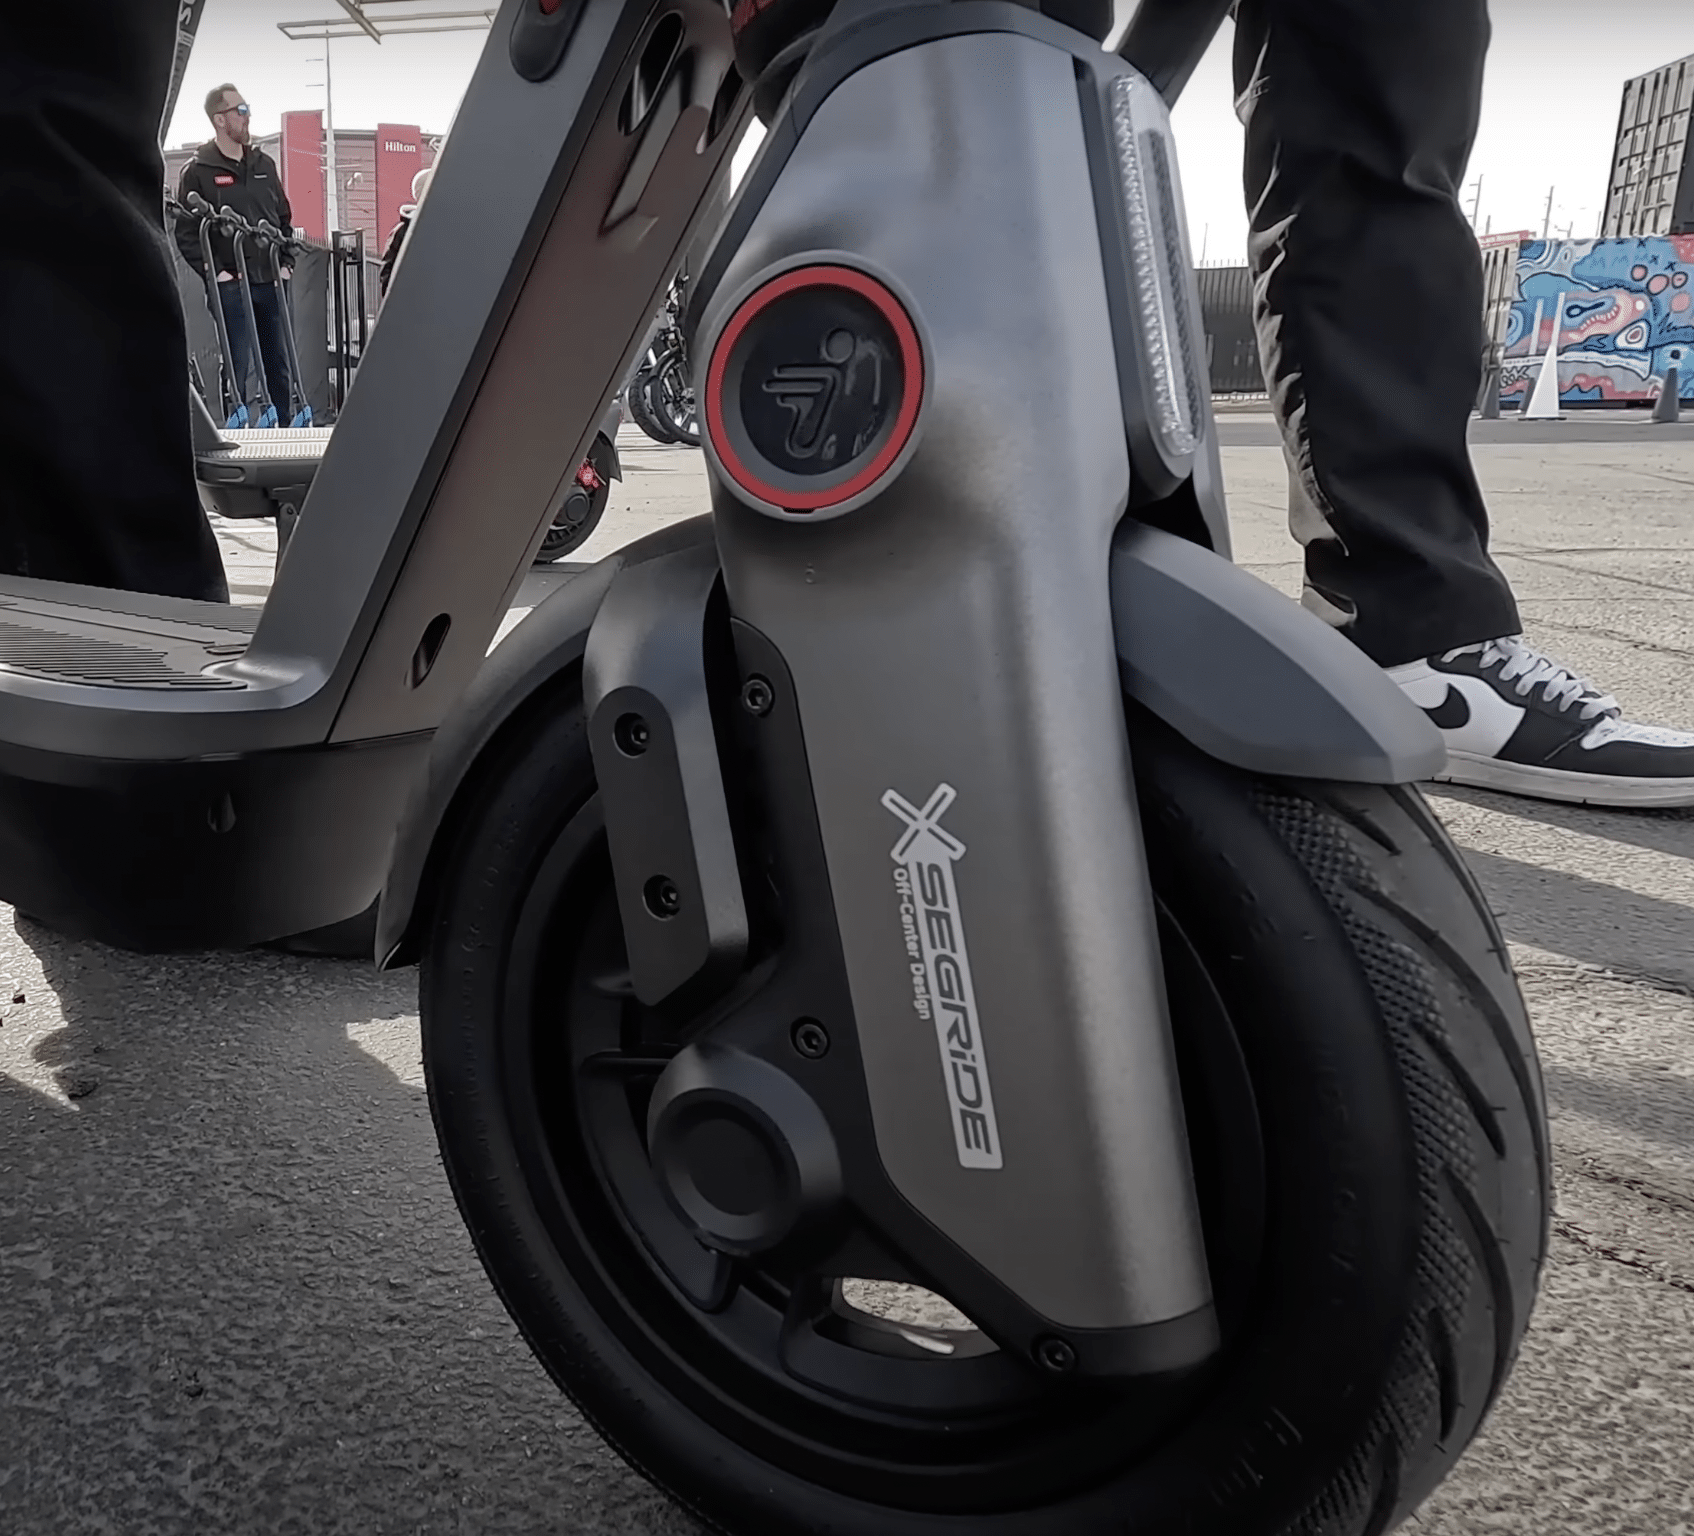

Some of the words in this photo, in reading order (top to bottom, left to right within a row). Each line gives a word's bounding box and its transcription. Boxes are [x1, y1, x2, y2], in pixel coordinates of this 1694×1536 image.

[385, 141, 416, 152] Hilton
[893, 867, 920, 959] Off-Center
[910, 962, 931, 1021] Design
